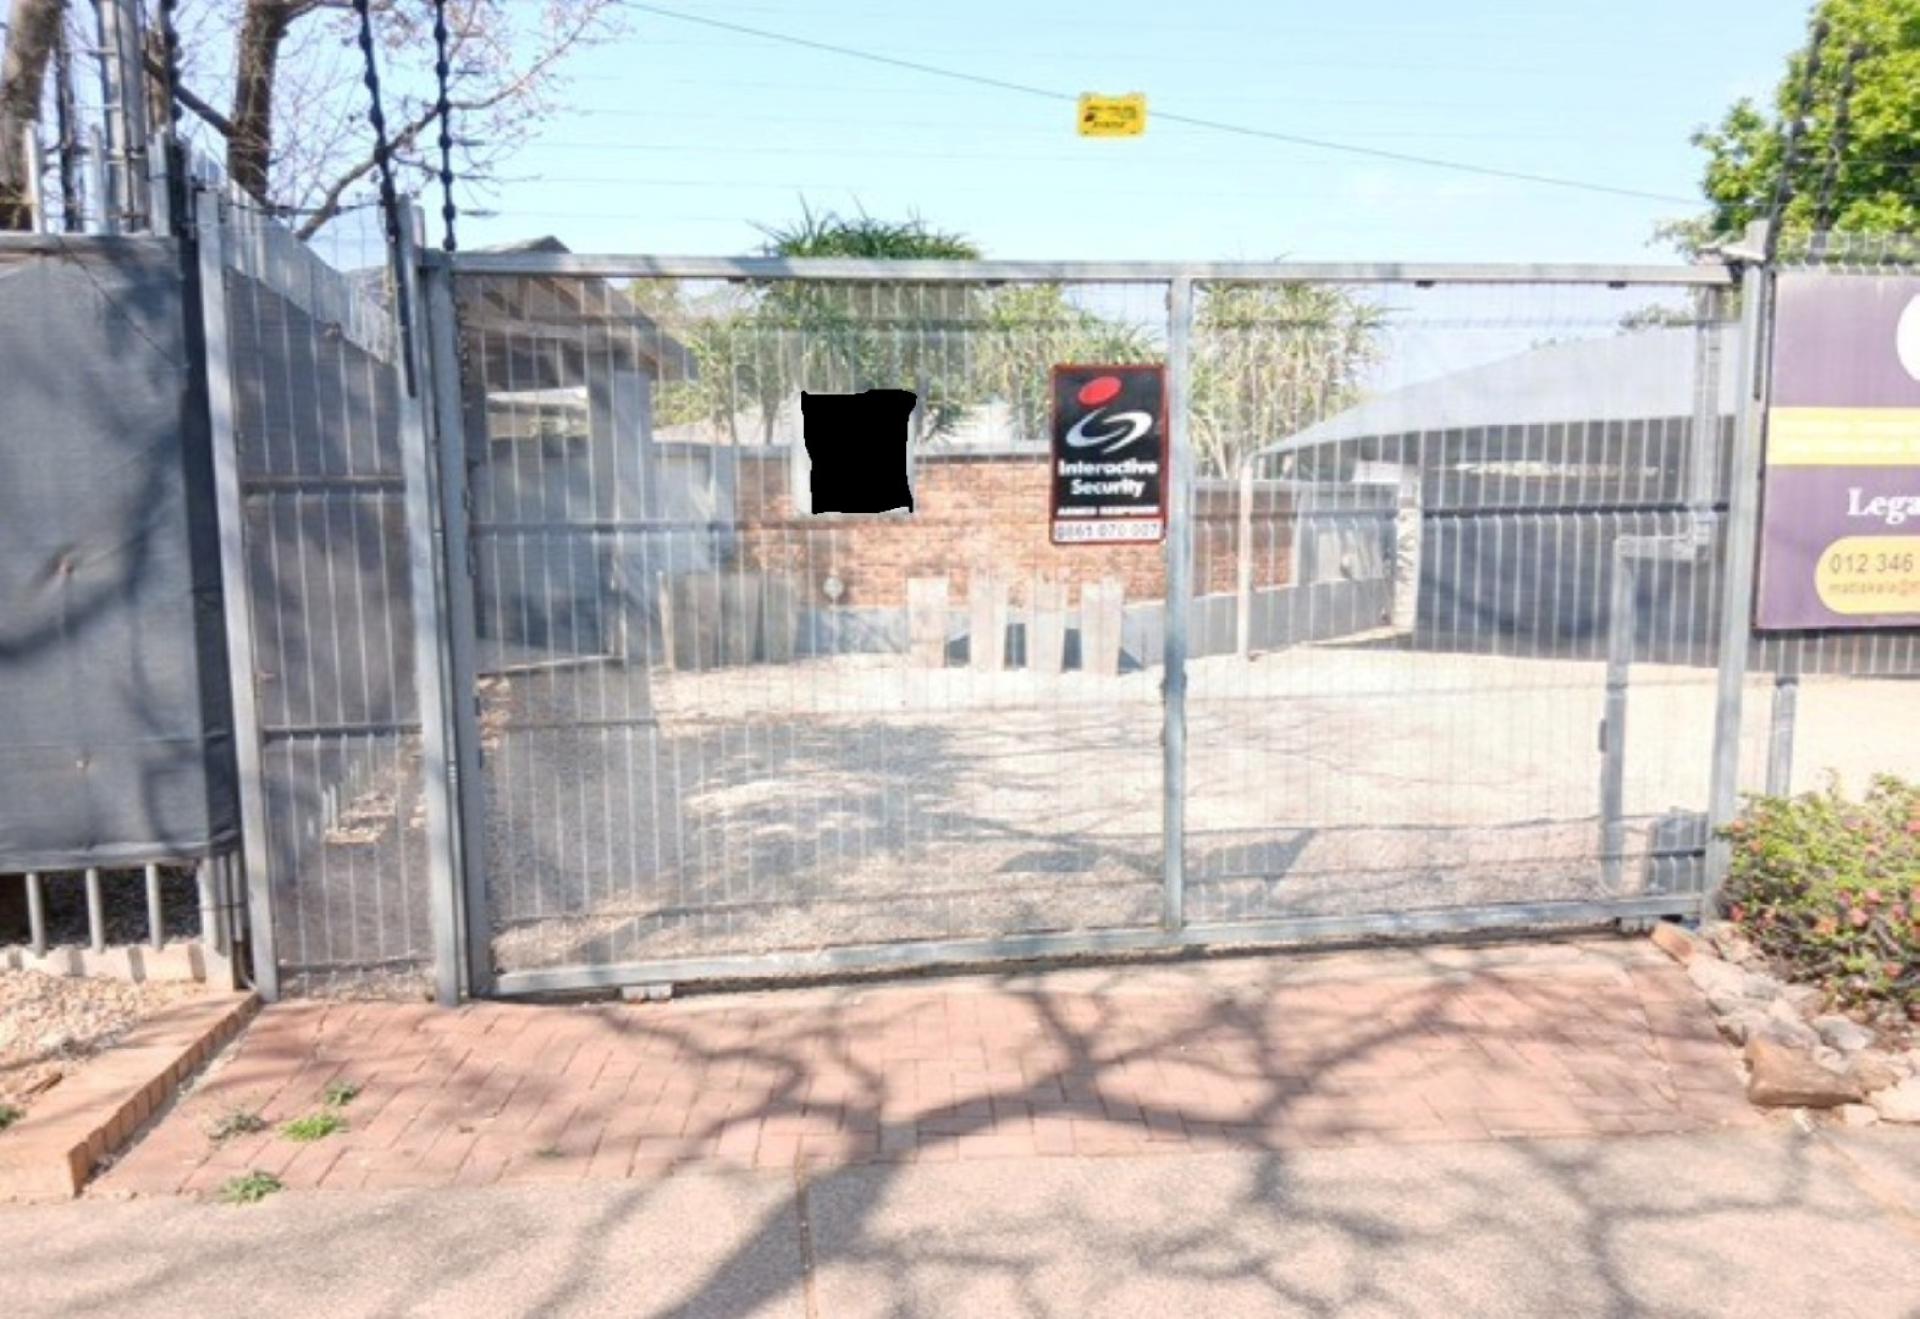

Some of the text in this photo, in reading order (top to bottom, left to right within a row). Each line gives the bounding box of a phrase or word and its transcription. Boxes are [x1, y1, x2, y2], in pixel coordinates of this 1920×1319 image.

[1058, 457, 1158, 476] Interactive
[1070, 478, 1146, 497] Security
[1829, 552, 1914, 575] 012 346
